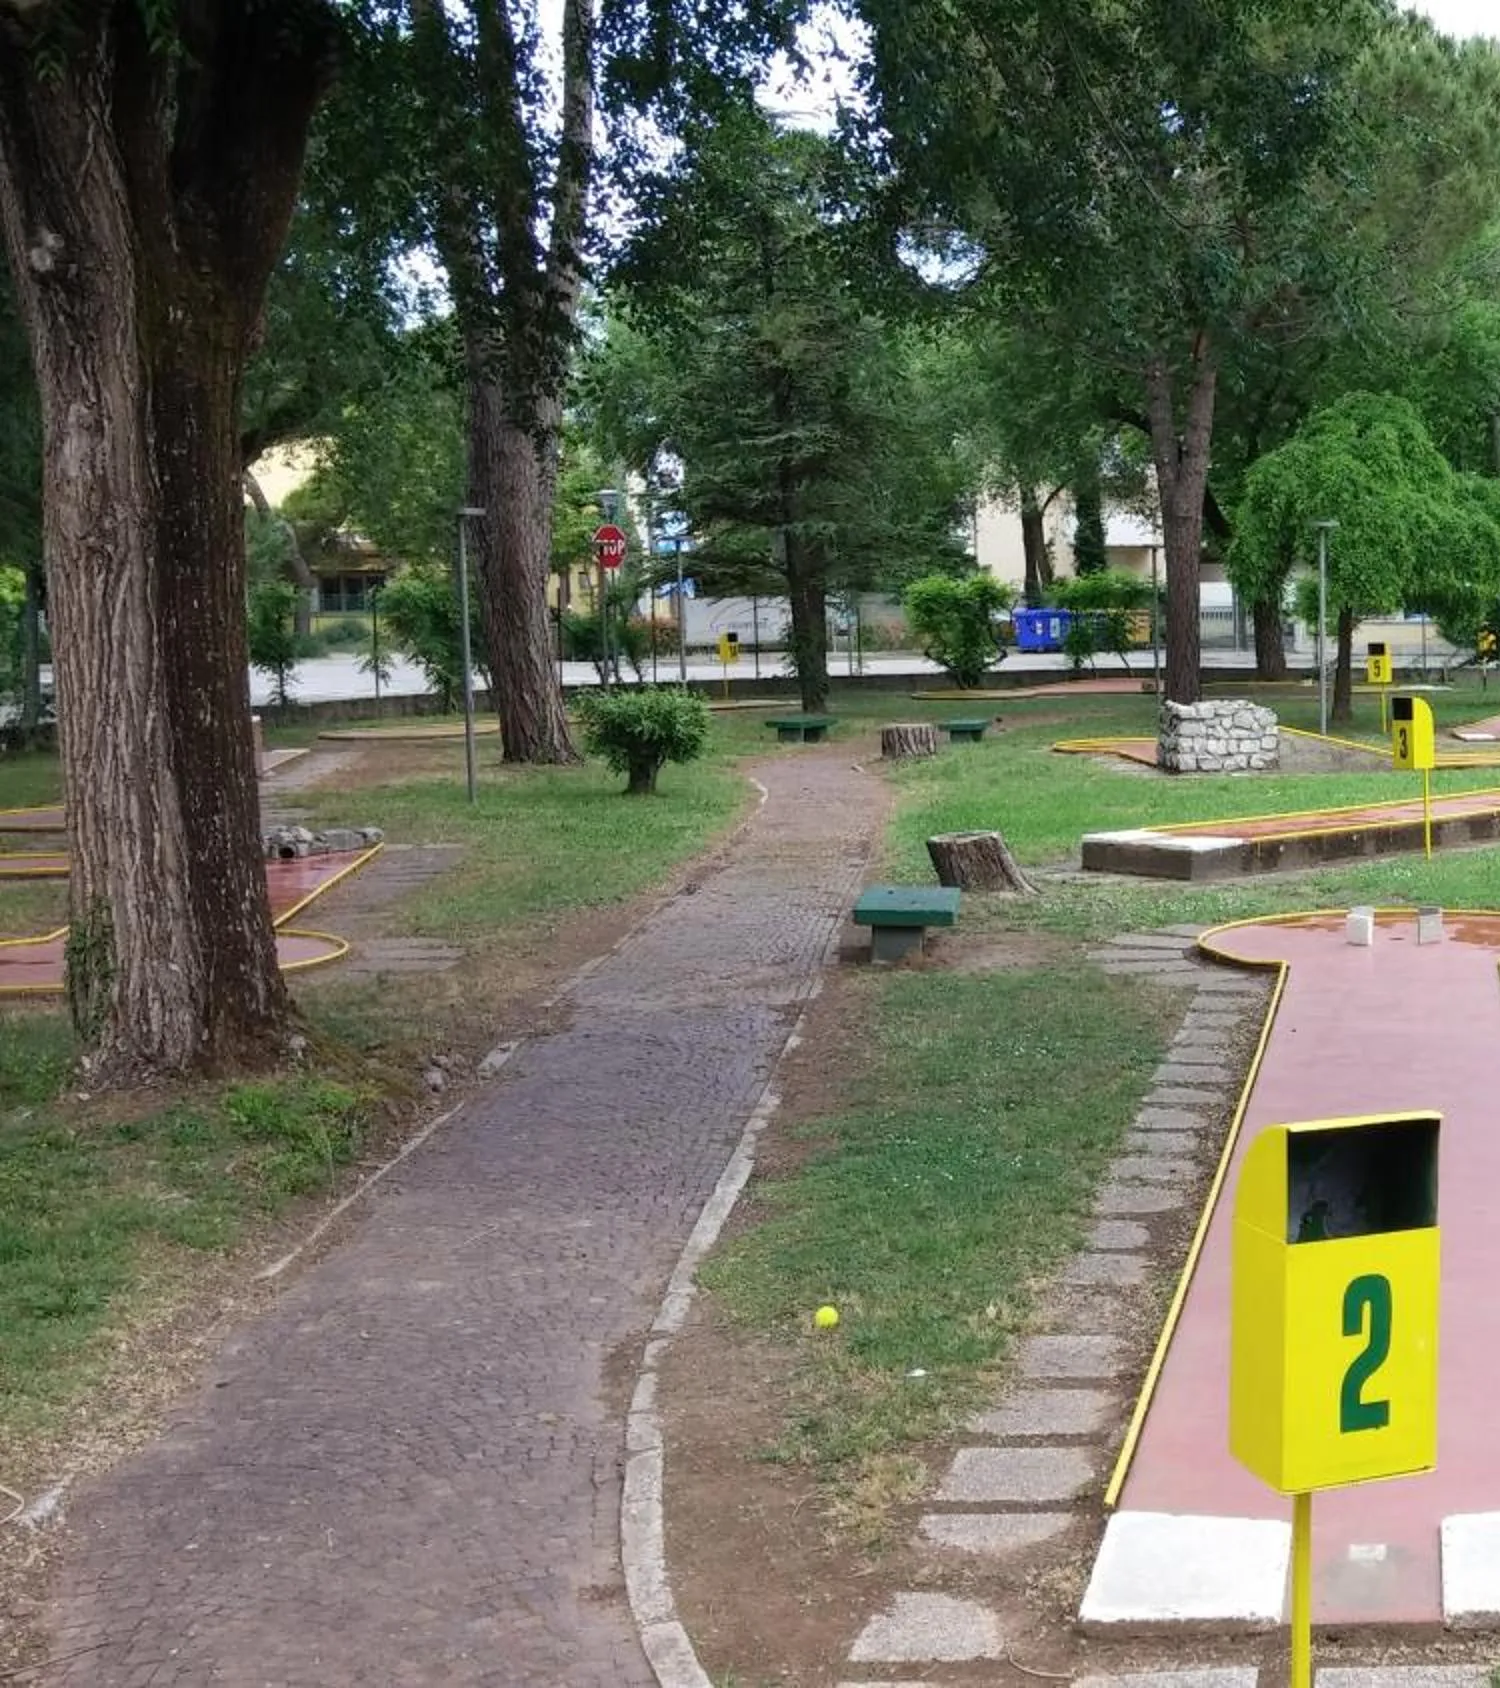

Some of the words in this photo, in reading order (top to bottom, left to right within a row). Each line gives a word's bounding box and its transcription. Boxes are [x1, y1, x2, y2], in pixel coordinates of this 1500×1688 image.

[596, 539, 625, 555] TOP
[1373, 660, 1381, 677] 5
[1400, 727, 1408, 758] 3
[1340, 1274, 1392, 1433] 2
